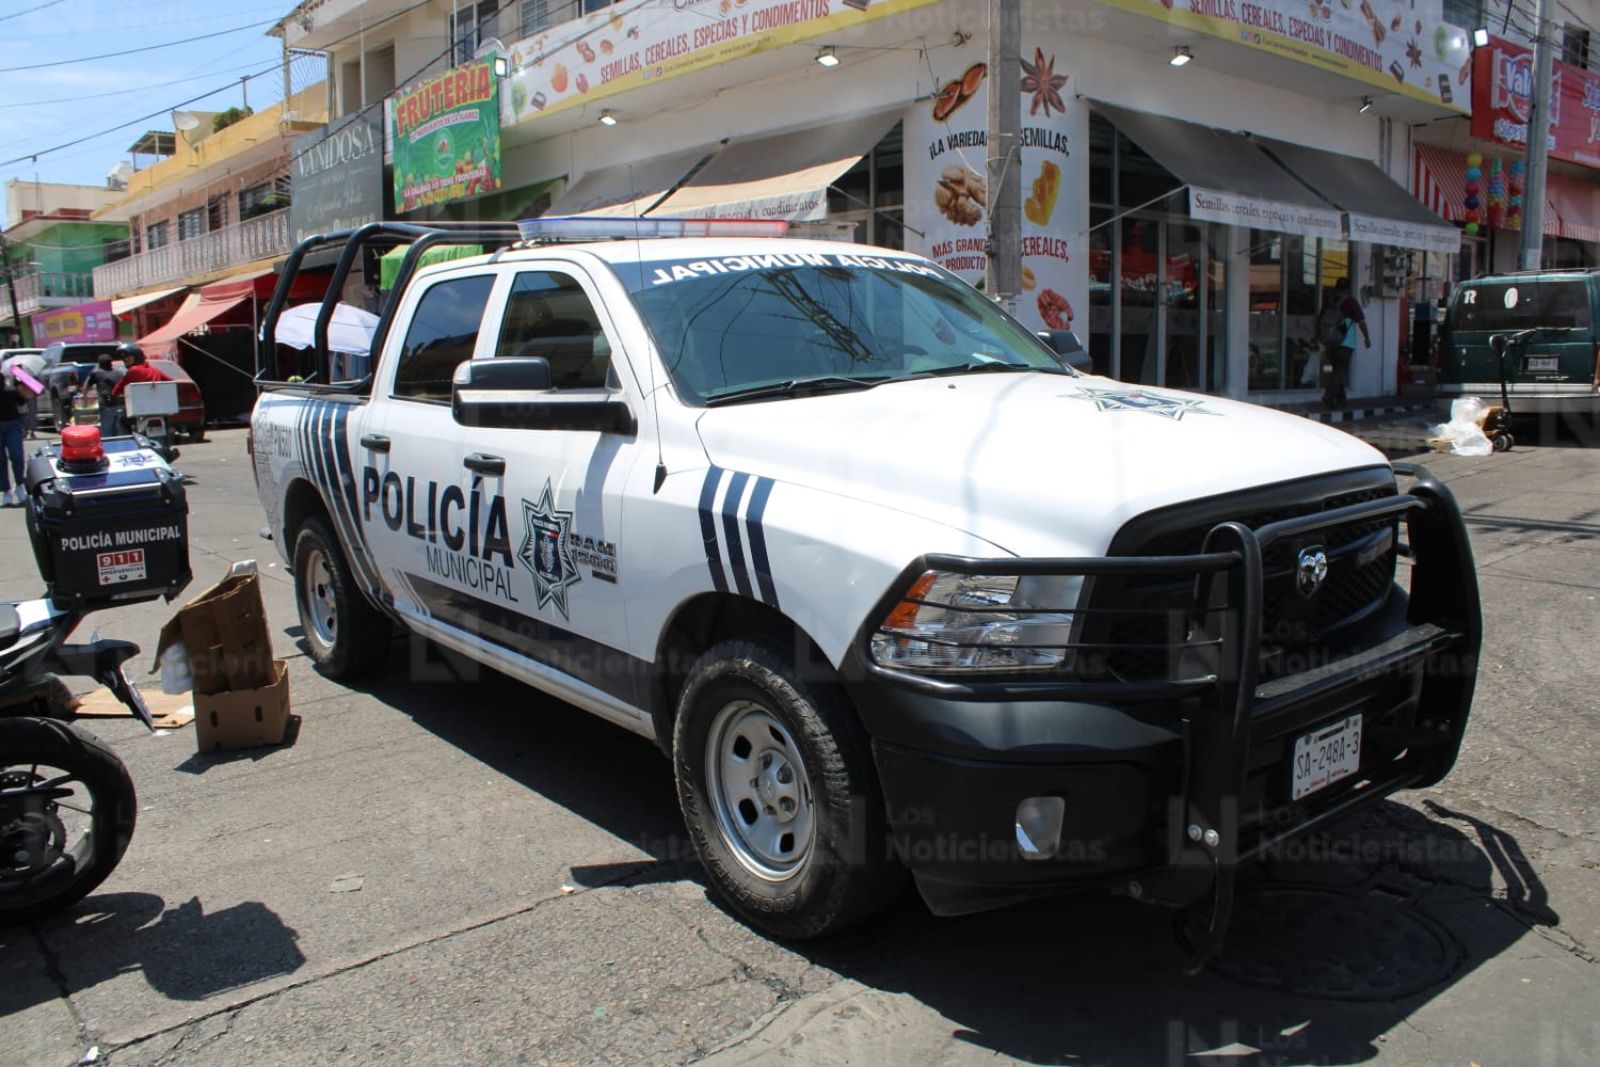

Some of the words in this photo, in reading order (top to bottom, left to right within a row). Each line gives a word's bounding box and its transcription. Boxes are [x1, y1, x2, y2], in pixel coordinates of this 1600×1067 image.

[600, 52, 643, 84] SEMILLAS,
[645, 33, 690, 66] CEREALES,
[694, 16, 738, 50] ESPECIAS
[742, 13, 749, 35] Y
[752, 0, 830, 32] CONDIMENTOS
[1241, 3, 1287, 36] CEREALES,
[1288, 15, 1324, 47] ESPECIAS
[1326, 29, 1334, 49] Y
[1334, 33, 1384, 72] CONDIMENTOS
[396, 64, 491, 137] FRUTERIA
[762, 199, 819, 217] condimentos
[61, 530, 113, 552] POLICÍA
[115, 525, 182, 546] MUNICIPAL
[362, 466, 515, 569] POLICÍA
[425, 543, 519, 604] MUNICIPAL
[571, 534, 617, 558] RAM
[571, 550, 618, 574] 1500
[1296, 731, 1360, 781] SA-248A-3
